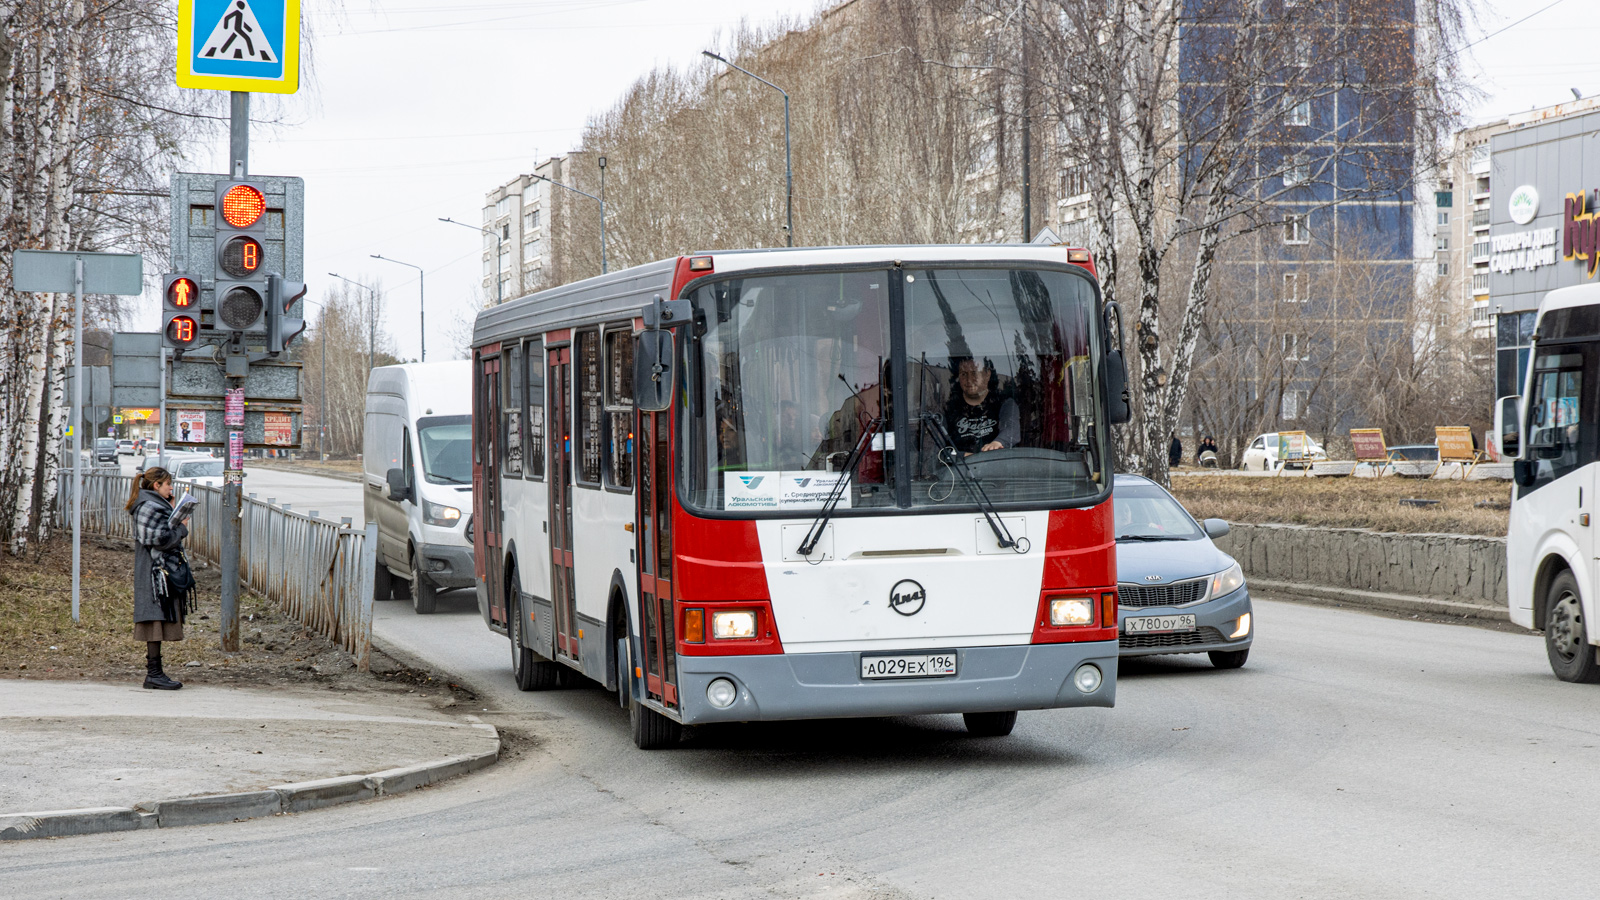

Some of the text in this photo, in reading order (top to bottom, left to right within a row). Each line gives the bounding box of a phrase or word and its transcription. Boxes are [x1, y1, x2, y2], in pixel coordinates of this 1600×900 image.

[1491, 227, 1554, 253] ТОВАРЫ ДЛЯ
[244, 243, 257, 269] 8
[1490, 247, 1554, 274] САДА И ДАЧИ
[172, 318, 193, 341] 73
[929, 656, 951, 668] 196
